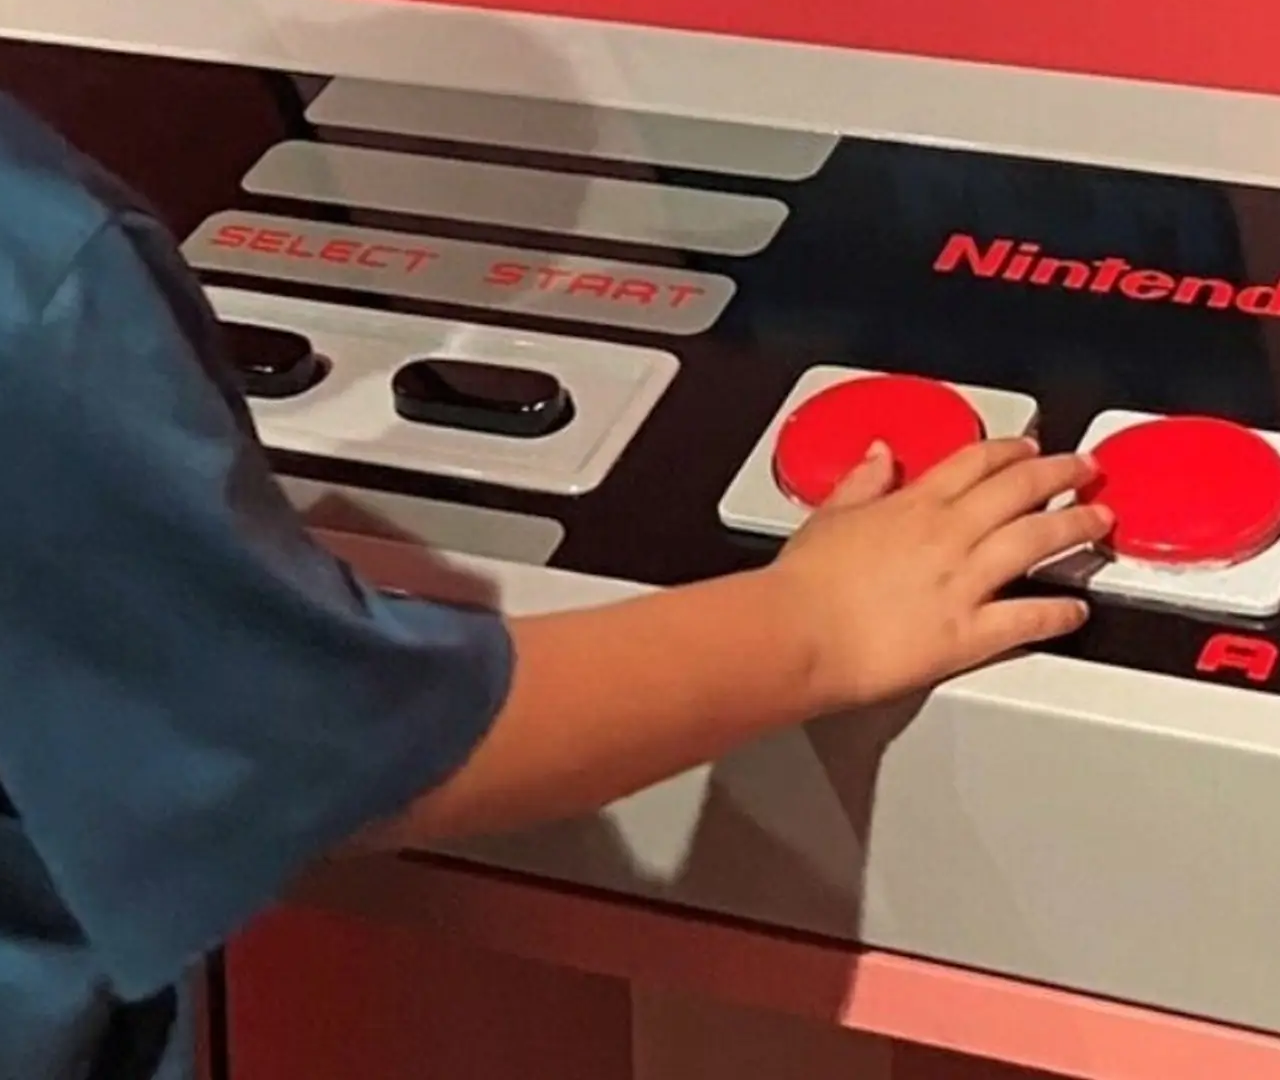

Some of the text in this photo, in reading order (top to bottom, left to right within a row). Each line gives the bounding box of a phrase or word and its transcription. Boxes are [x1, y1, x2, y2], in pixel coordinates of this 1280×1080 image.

[210, 224, 706, 309] SELECT START
[1195, 632, 1279, 681] A
